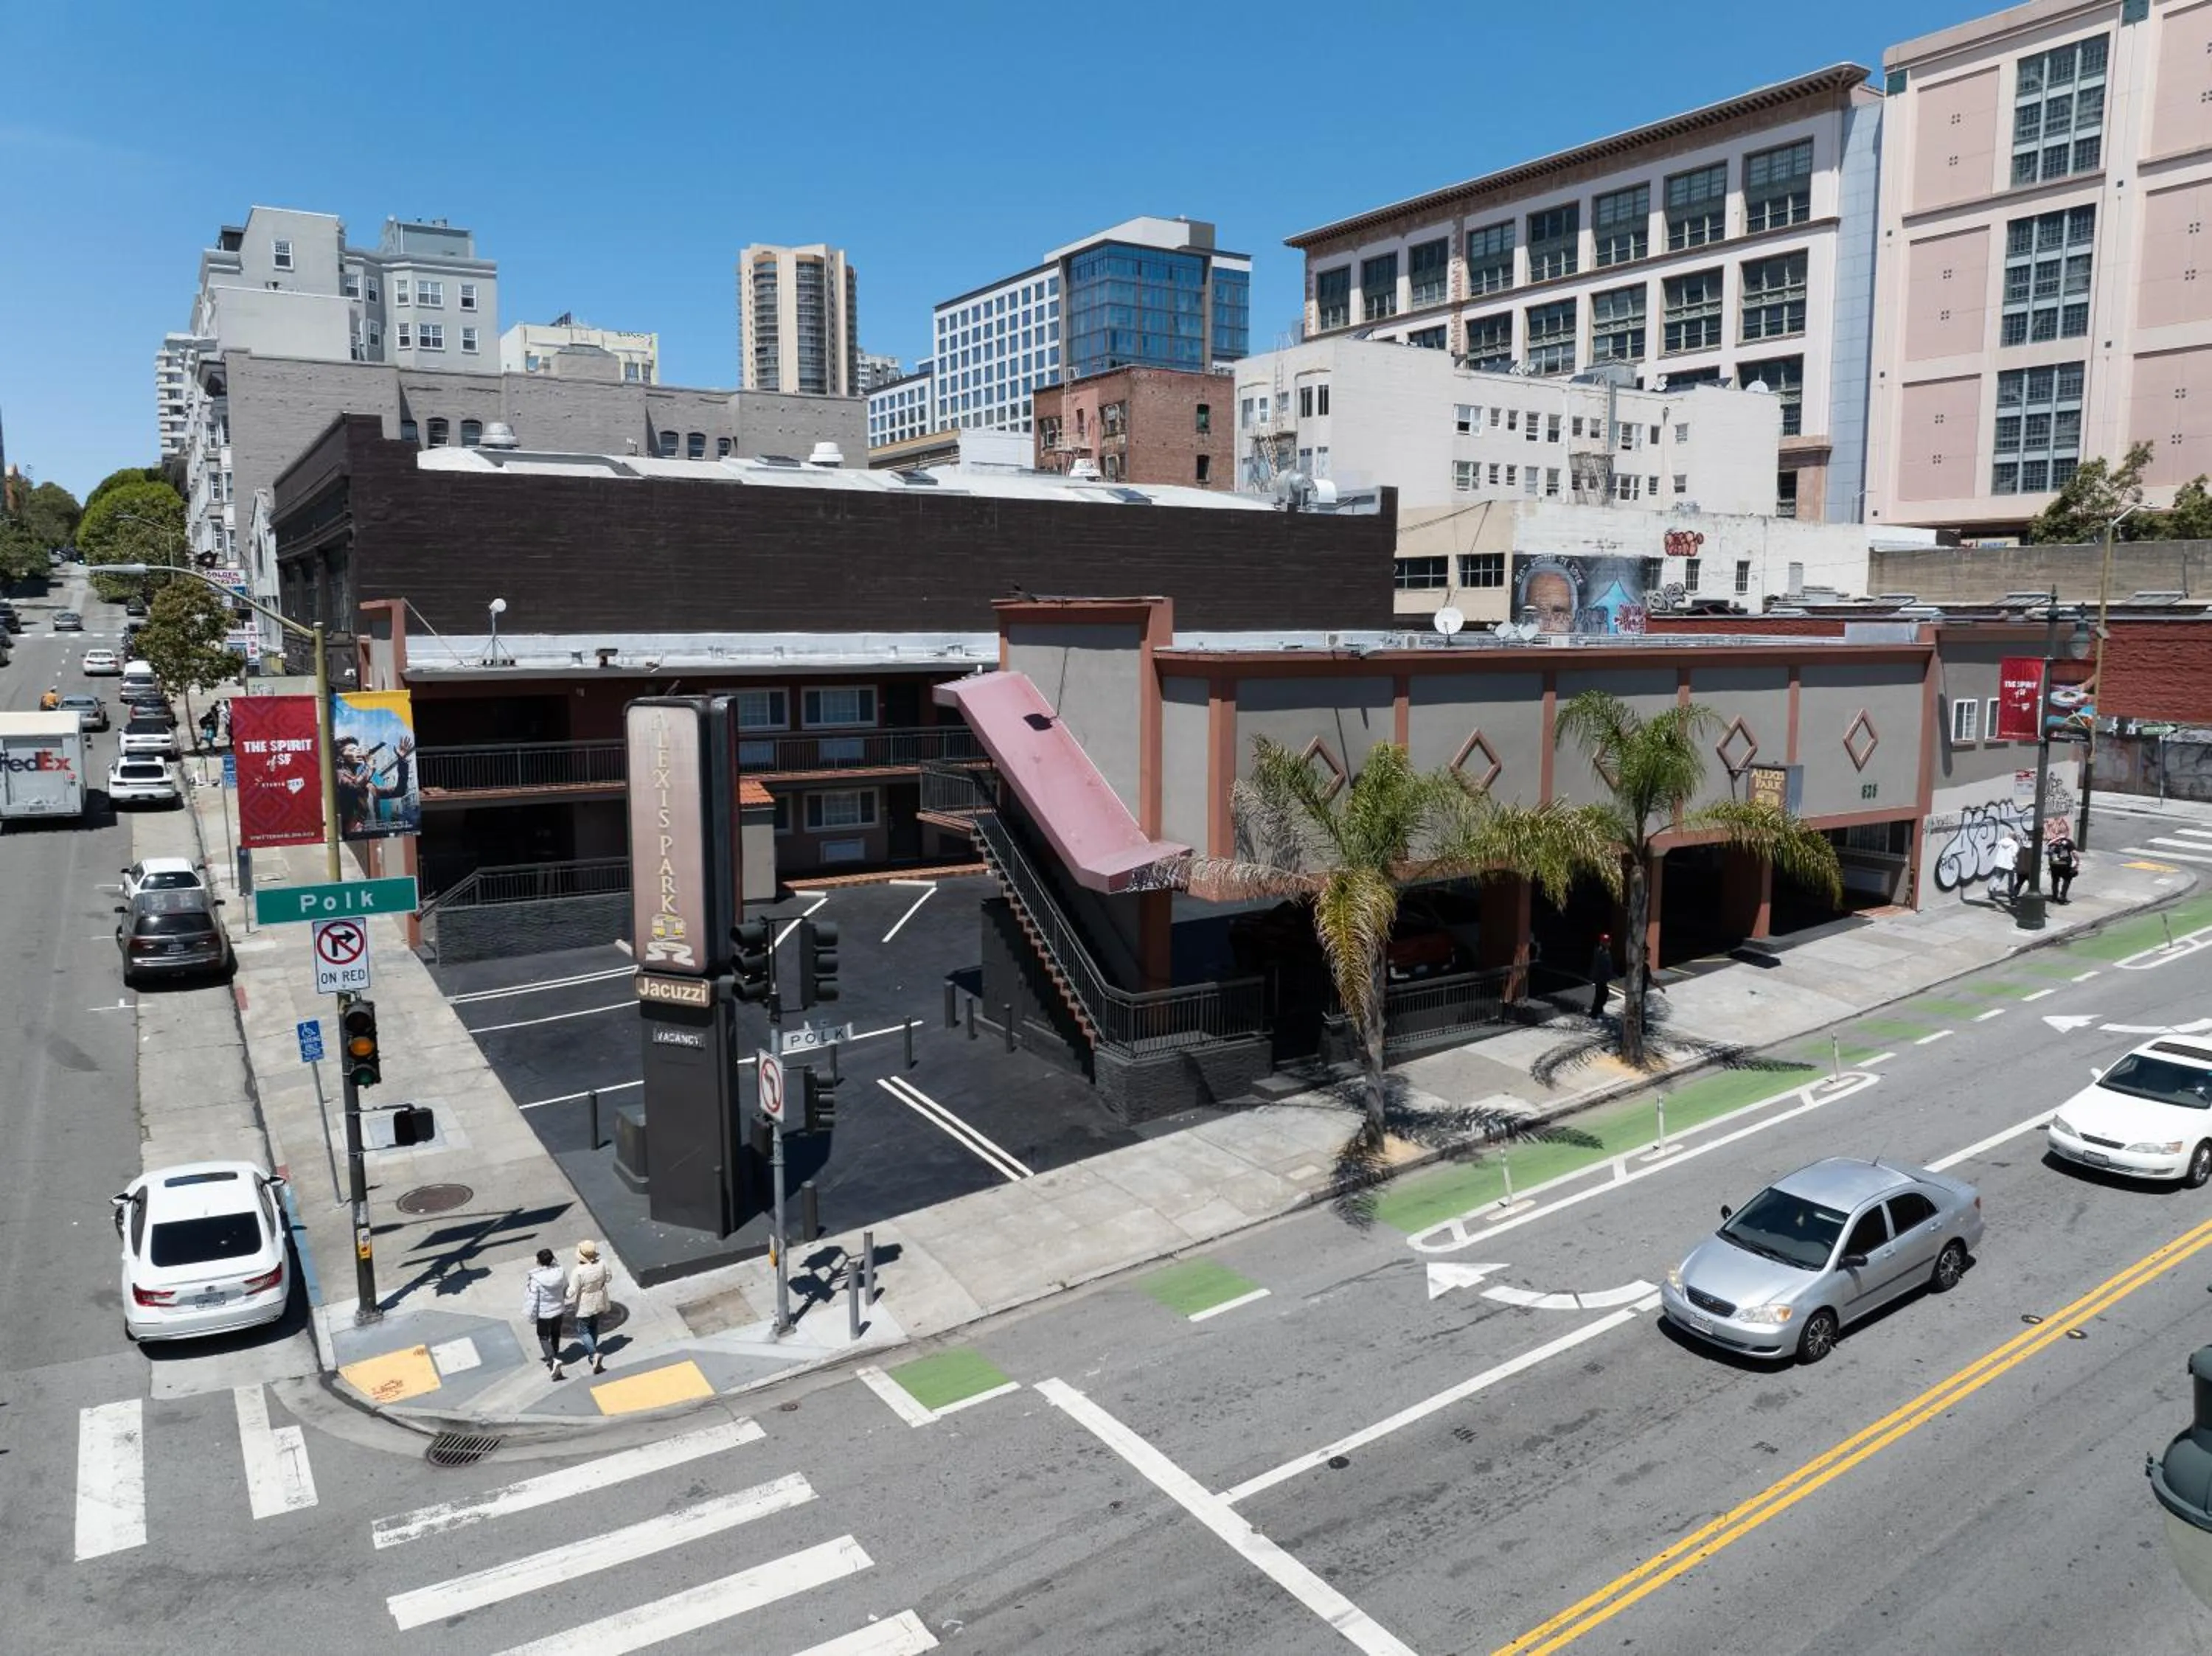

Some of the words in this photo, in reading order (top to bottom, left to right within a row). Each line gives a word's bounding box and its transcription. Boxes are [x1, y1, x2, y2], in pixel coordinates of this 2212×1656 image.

[243, 740, 267, 754] THE
[270, 739, 313, 752] SPIRIT
[277, 754, 292, 765] SF
[652, 710, 670, 829] ALEXIS
[1755, 778, 1782, 791] PARK
[660, 835, 676, 914] PARK
[300, 891, 374, 913] Polk
[321, 973, 337, 984] ON
[342, 970, 366, 983] RED
[639, 977, 706, 1003] Jacuzzi
[657, 1031, 700, 1046] VACANCY
[790, 1028, 844, 1047] POLK
